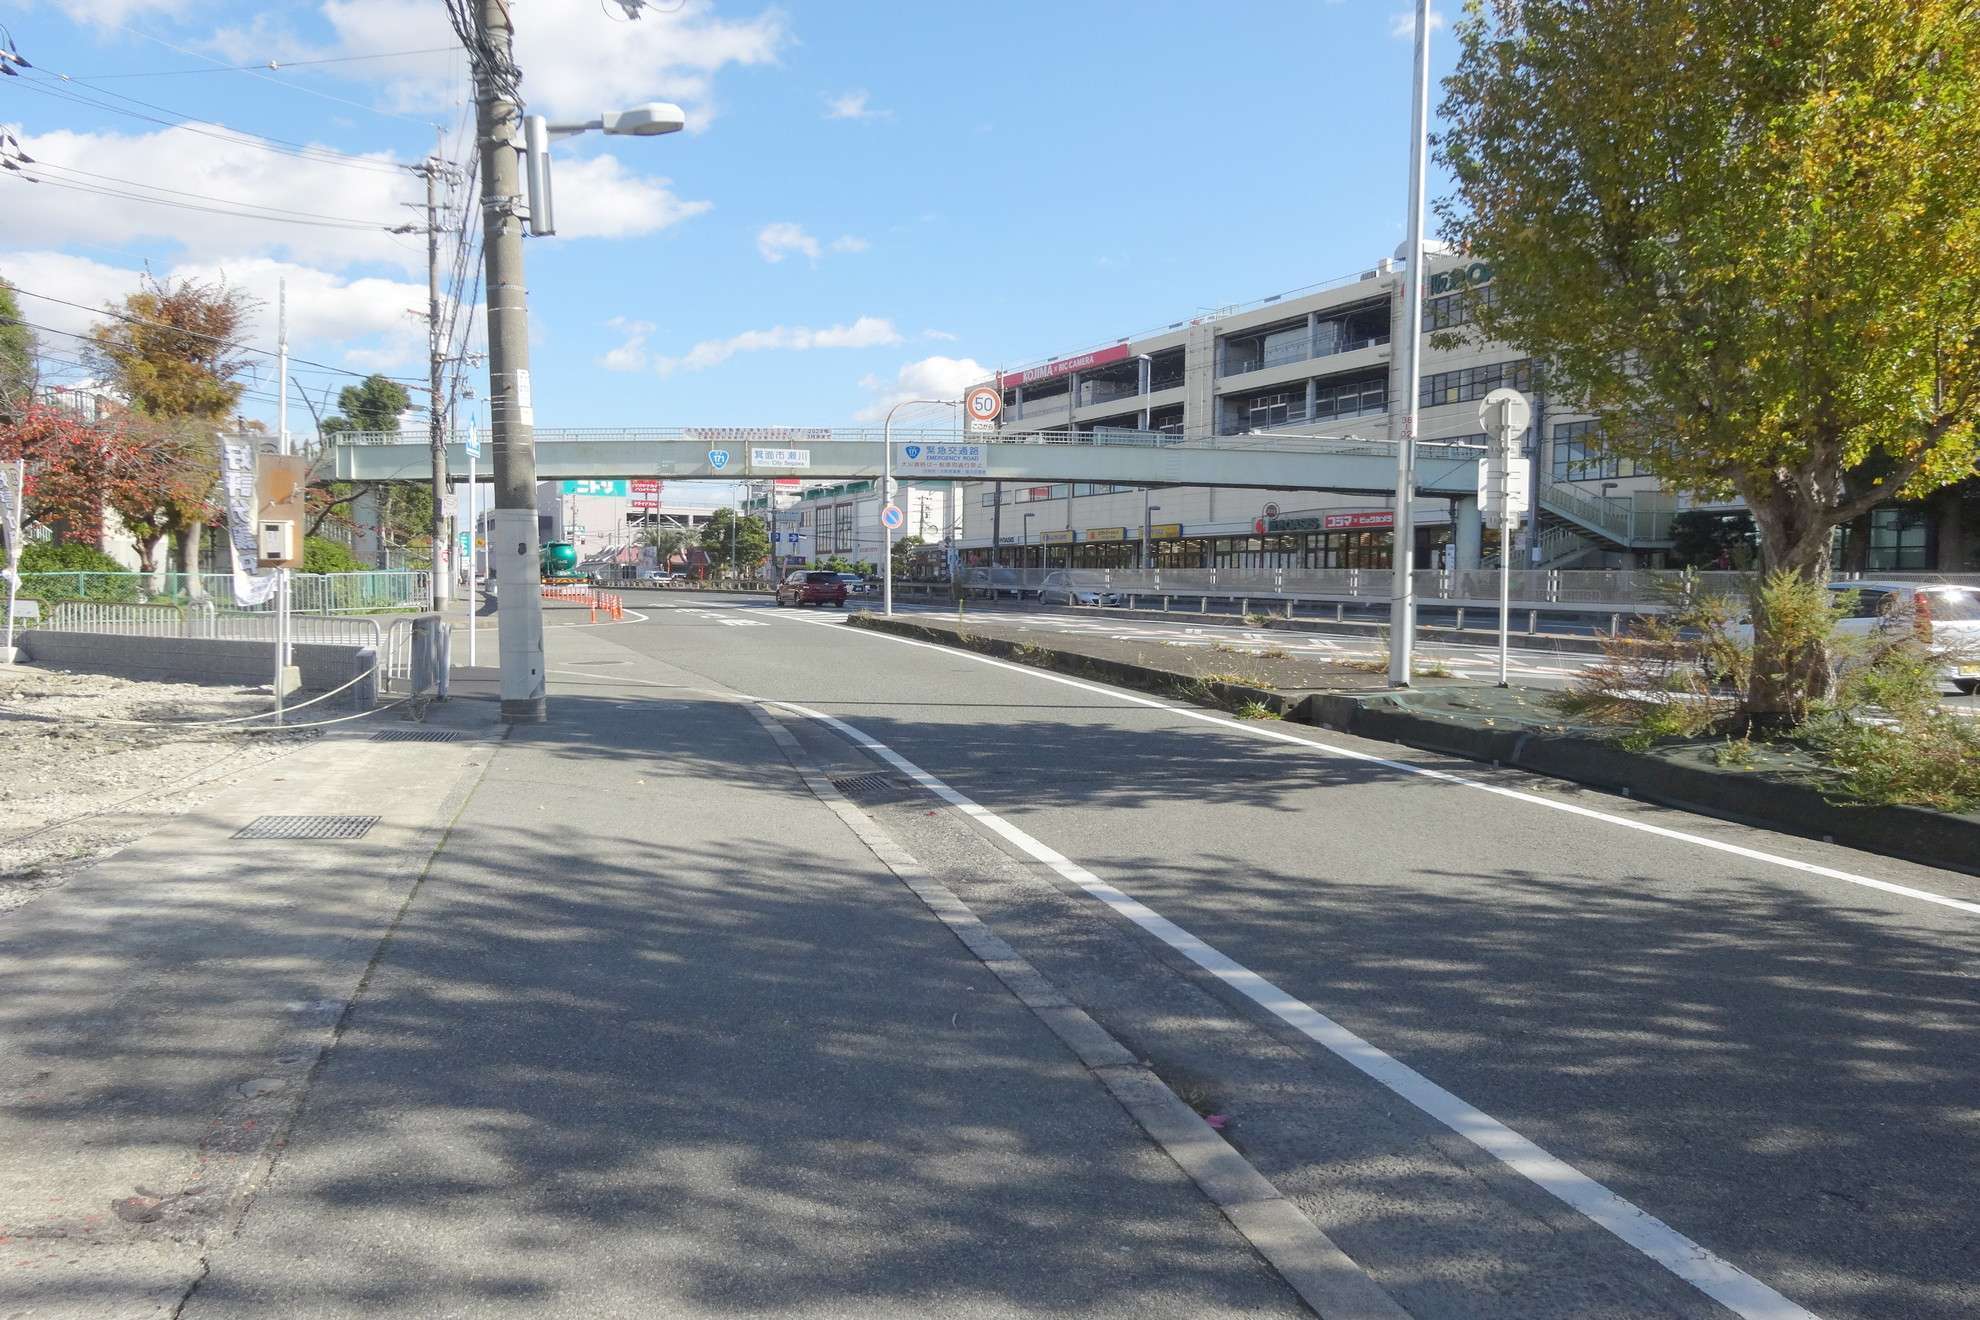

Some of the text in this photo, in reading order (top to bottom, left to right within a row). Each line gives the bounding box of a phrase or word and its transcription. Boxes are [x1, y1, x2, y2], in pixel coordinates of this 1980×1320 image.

[1023, 364, 1054, 384] KOJIMA
[975, 396, 993, 412] 50
[926, 445, 979, 455] 緊急交通路
[713, 455, 725, 463] 171
[1327, 515, 1352, 527] コジマ
